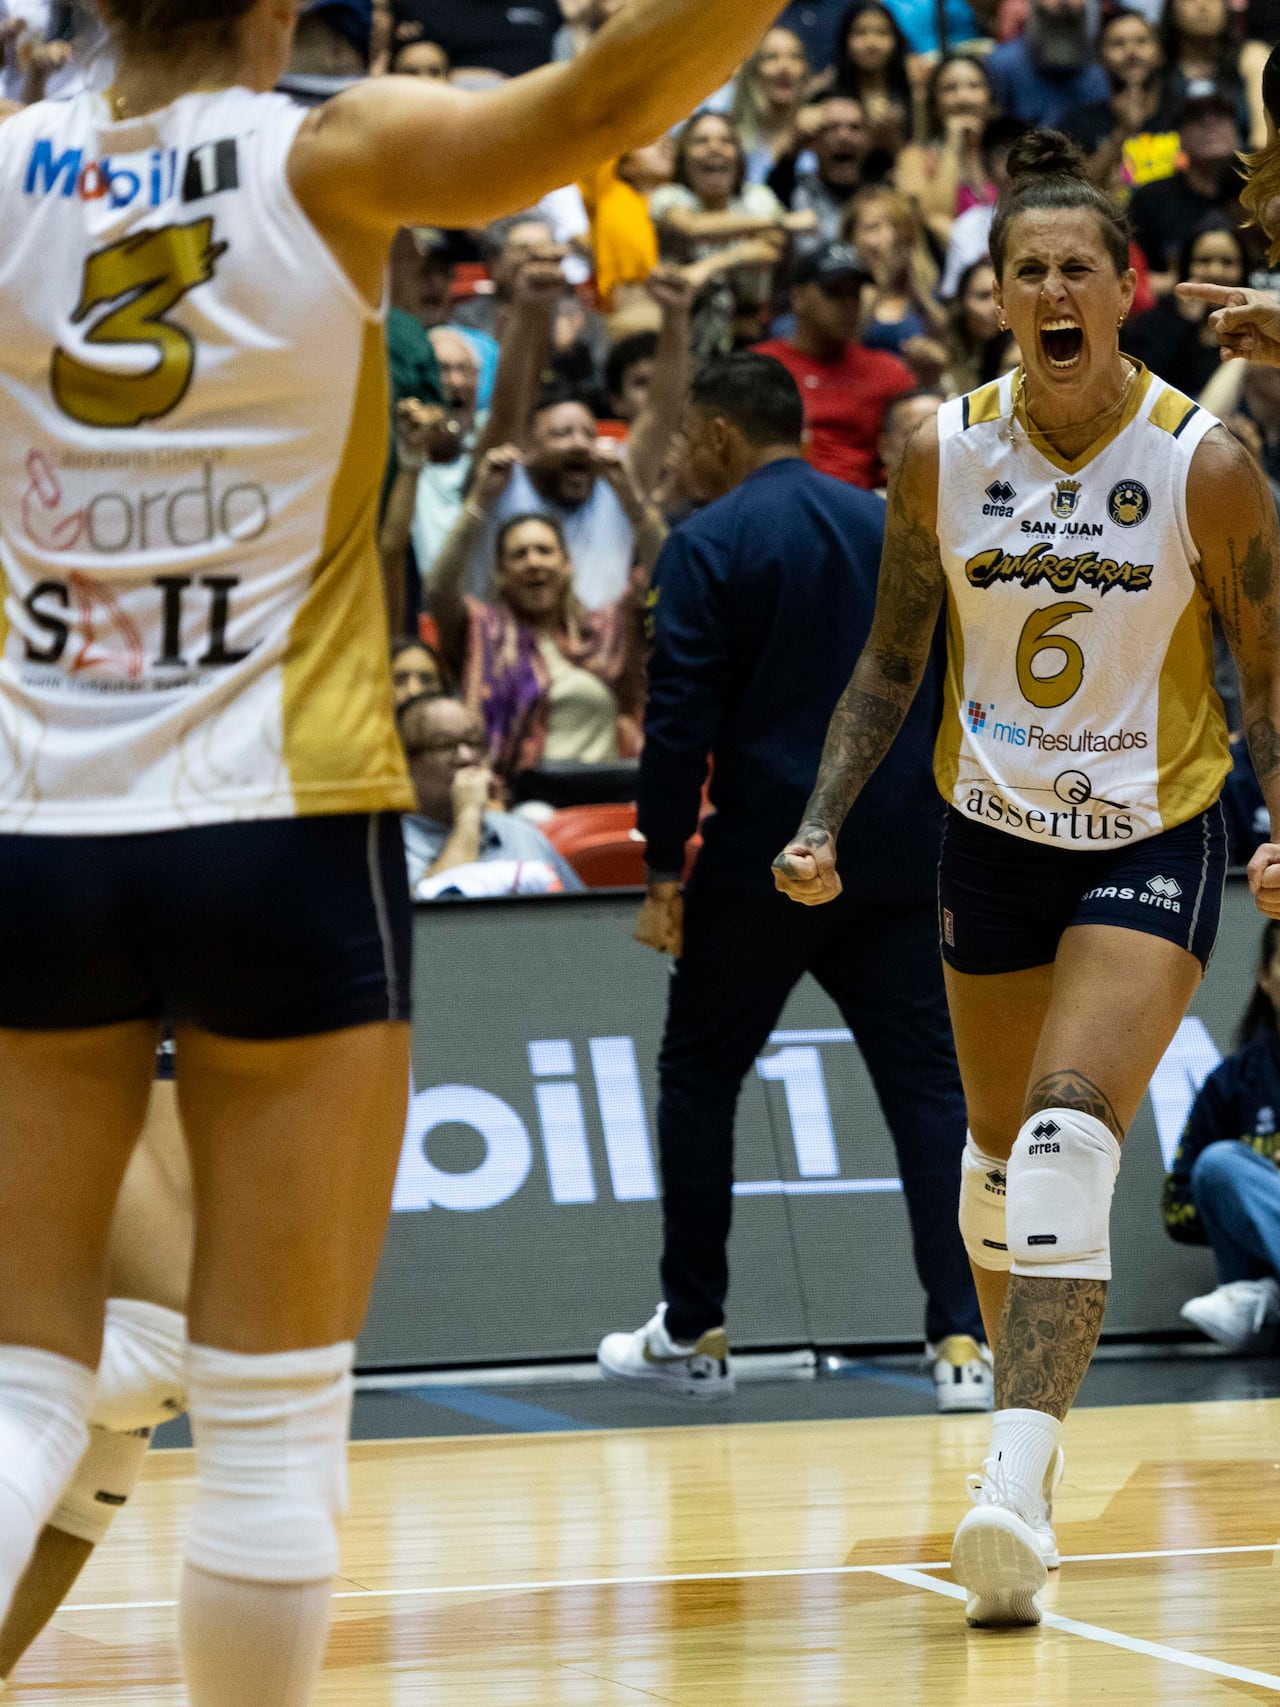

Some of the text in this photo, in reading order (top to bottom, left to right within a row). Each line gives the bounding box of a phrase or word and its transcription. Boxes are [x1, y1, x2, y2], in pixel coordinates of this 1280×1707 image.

[24, 139, 176, 209] Mobil
[50, 216, 229, 428] 3
[982, 503, 1014, 518] errea
[1020, 520, 1104, 537] SAN JUAN
[1016, 601, 1093, 708] 6
[967, 788, 1134, 840] assertus
[1139, 892, 1181, 914] errea
[390, 1035, 841, 1212] bil 1
[1028, 1142, 1060, 1155] errea
